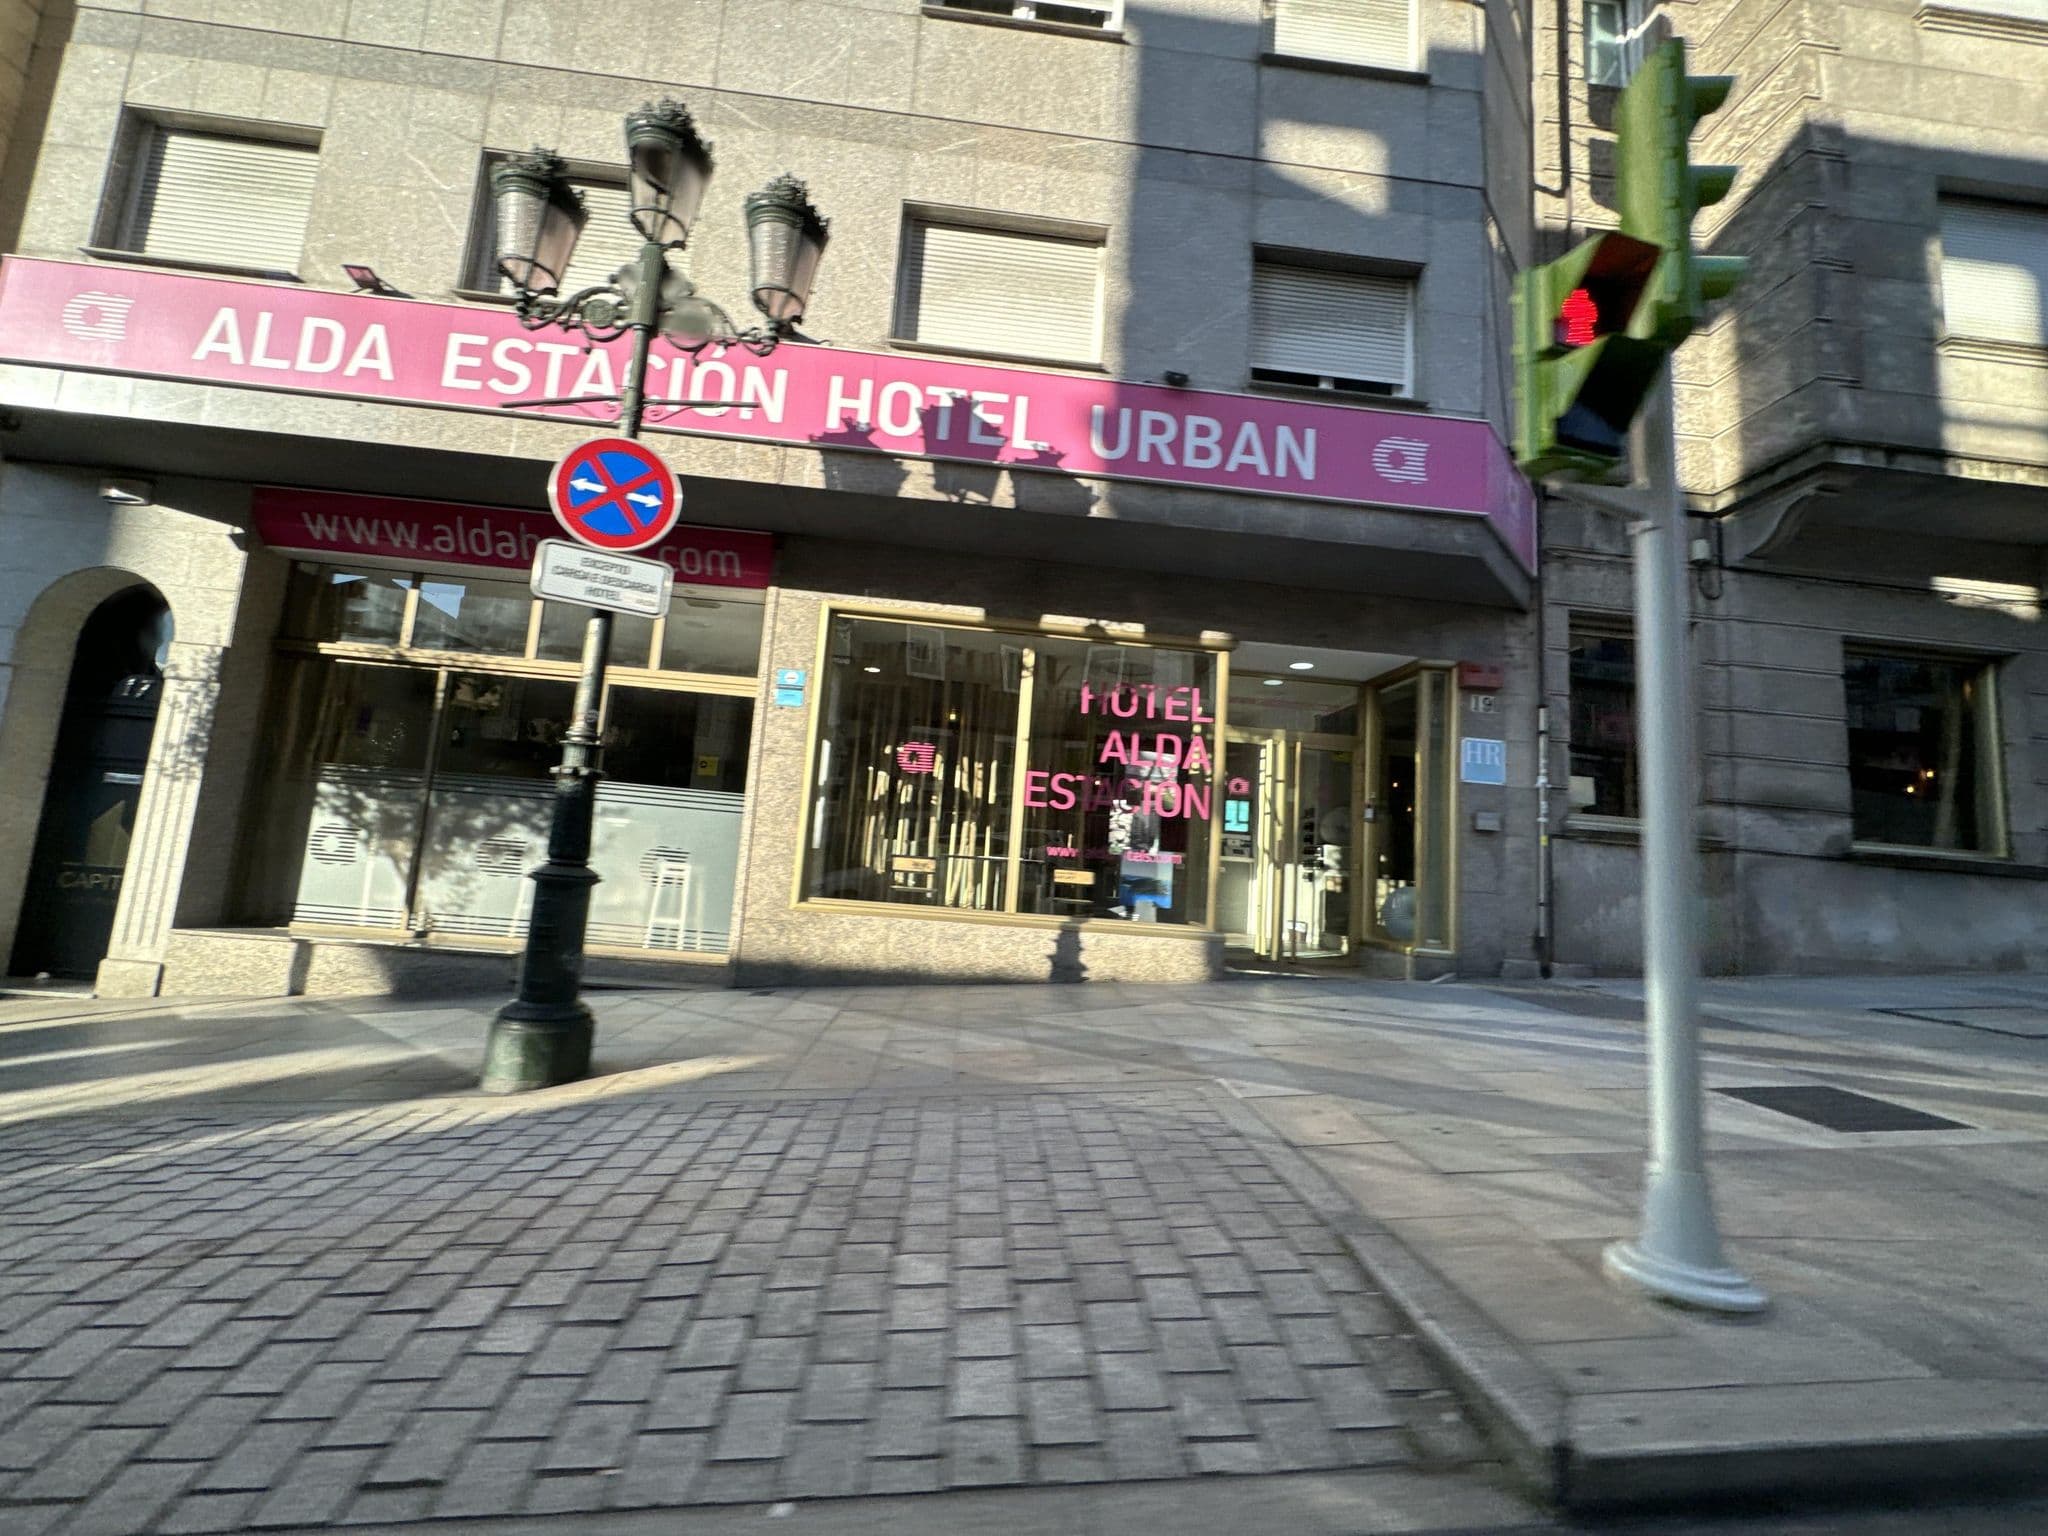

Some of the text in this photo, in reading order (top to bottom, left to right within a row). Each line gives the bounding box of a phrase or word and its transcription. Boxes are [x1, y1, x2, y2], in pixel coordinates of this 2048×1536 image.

[192, 306, 1317, 481] ALDA ESTACIÓN HOTEL URBAN
[302, 511, 742, 578] www.aldahcom
[121, 678, 155, 698] 17
[1080, 680, 1214, 723] HOTEL
[1099, 729, 1212, 776] ALDA
[1466, 740, 1501, 766] HR
[1023, 770, 1211, 820] ESTACIÓN
